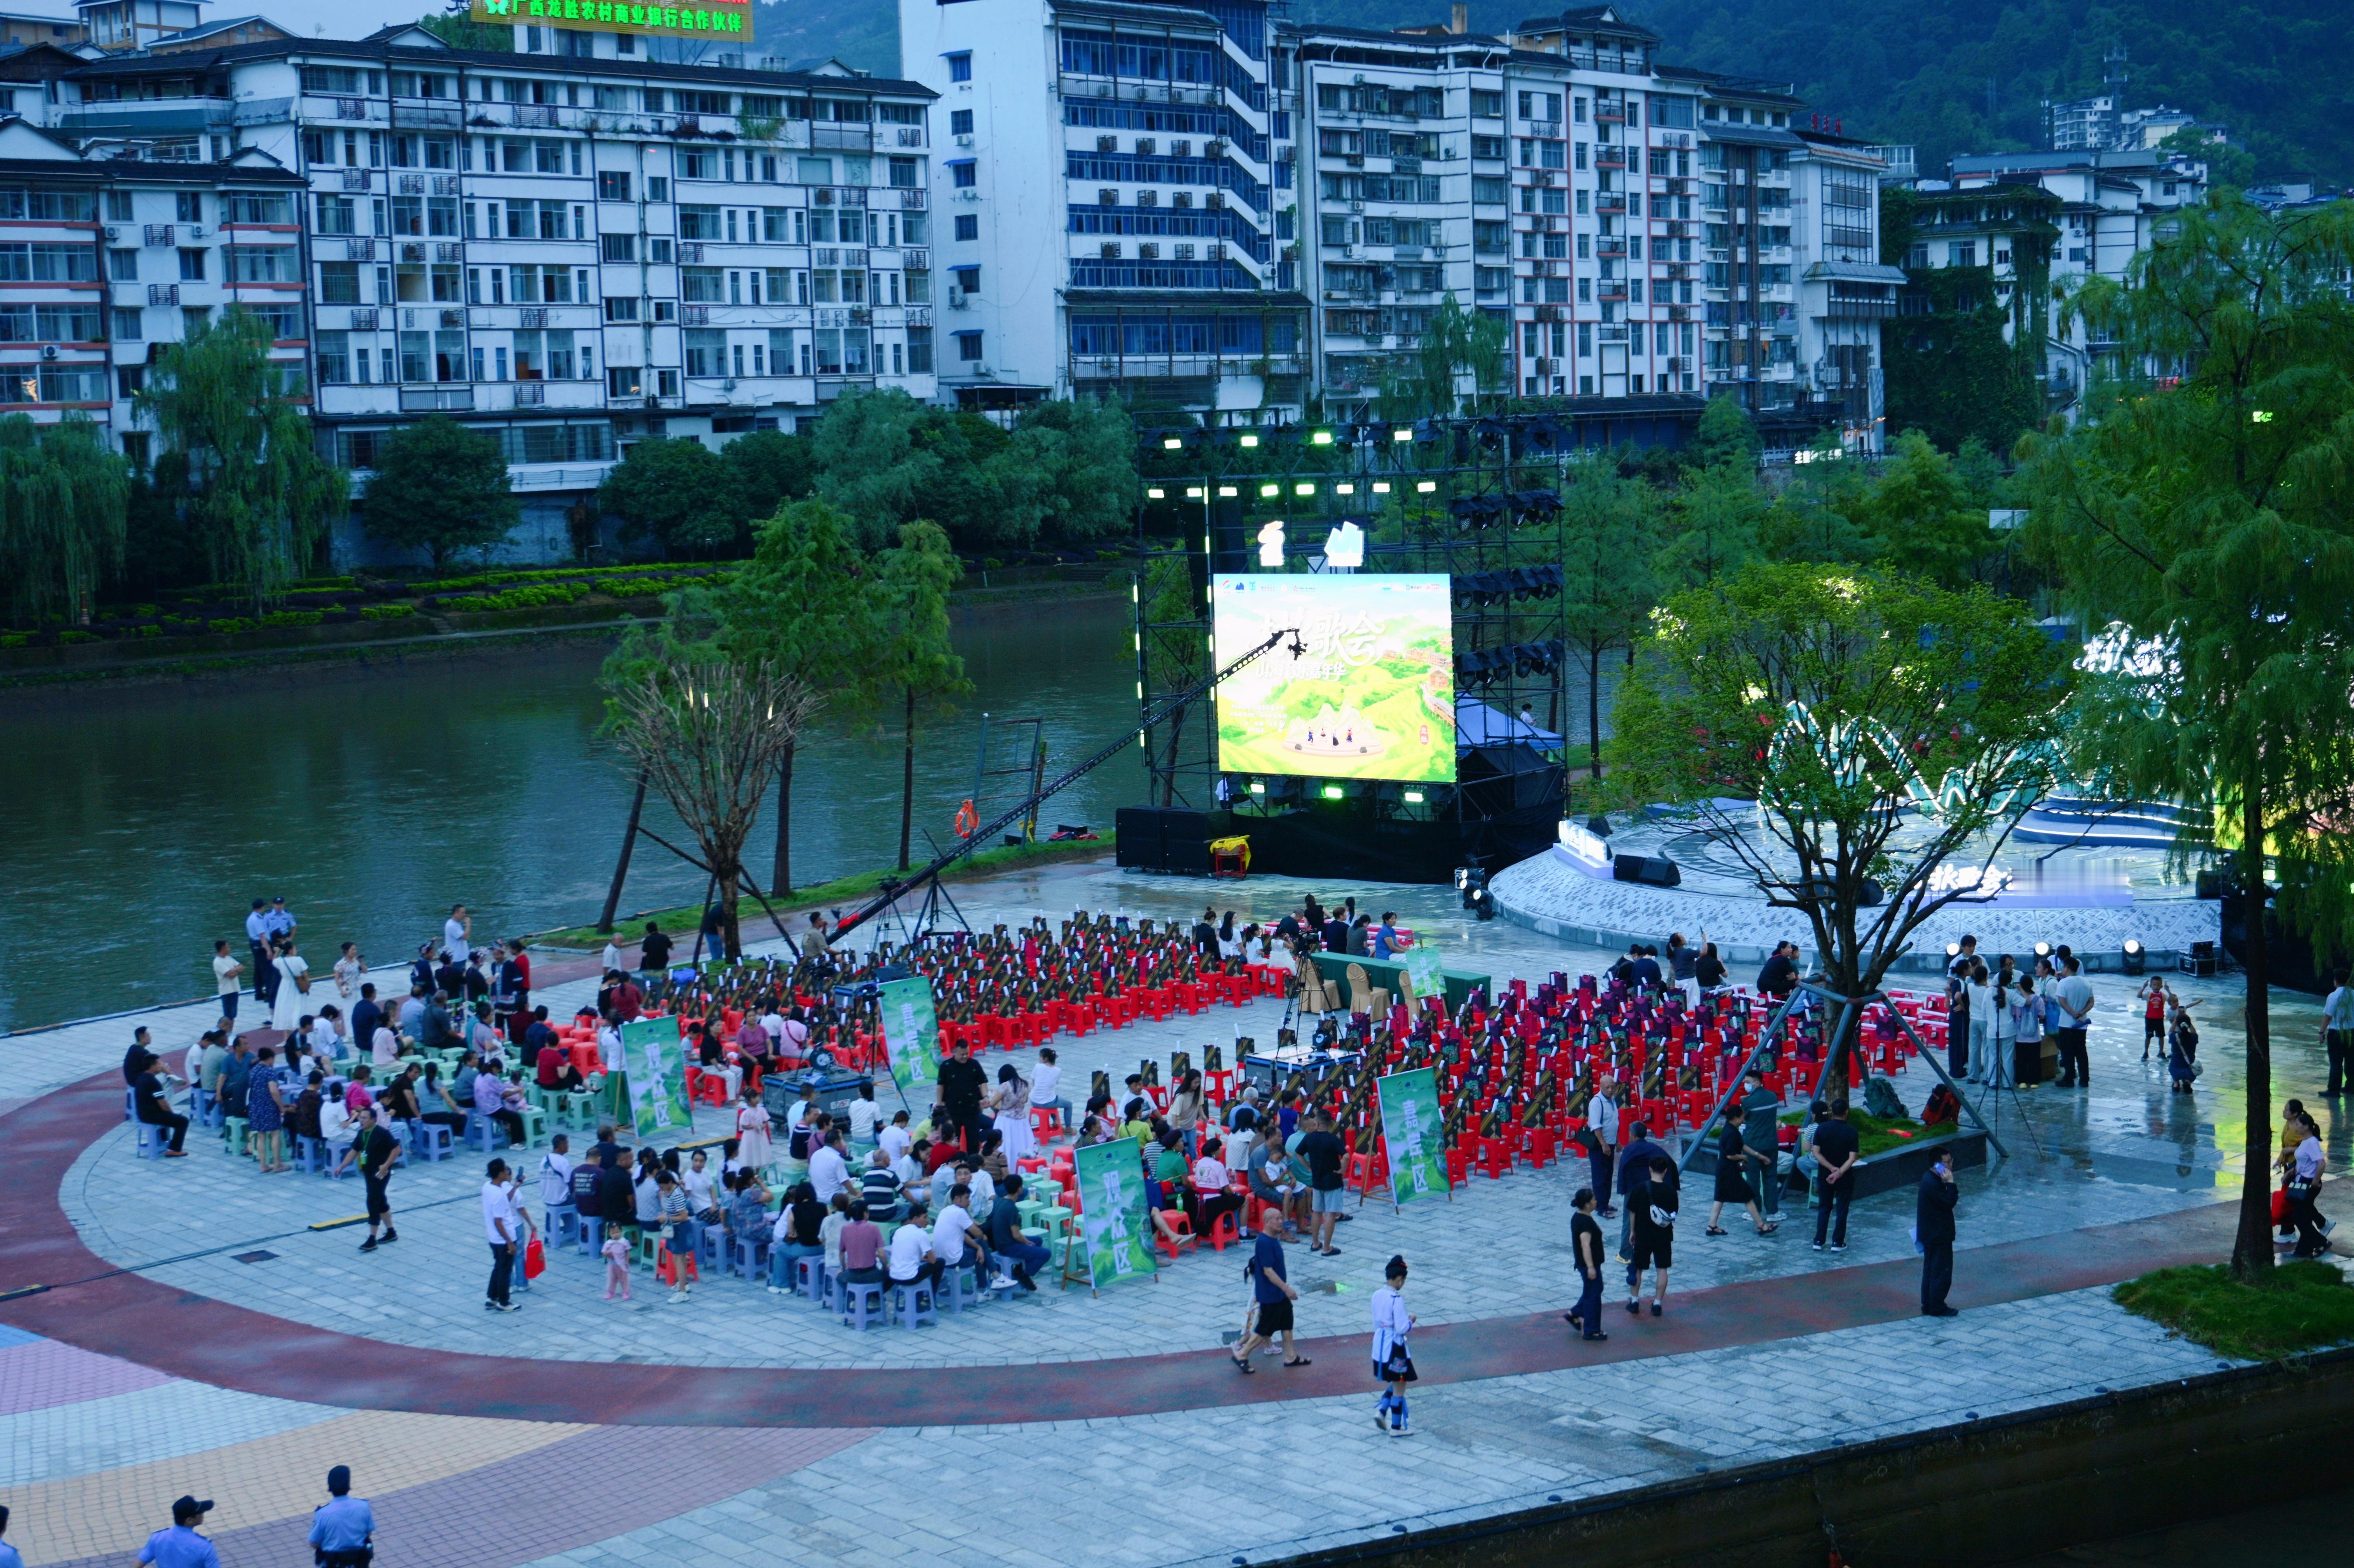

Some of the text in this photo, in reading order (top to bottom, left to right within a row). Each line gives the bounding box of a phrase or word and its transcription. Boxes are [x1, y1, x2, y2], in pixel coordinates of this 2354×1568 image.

[644, 1042, 672, 1128] 观众区
[900, 1002, 926, 1081] 嘉宾区
[1402, 1099, 1429, 1194] 嘉宾区
[1102, 1169, 1133, 1275] 观众区
